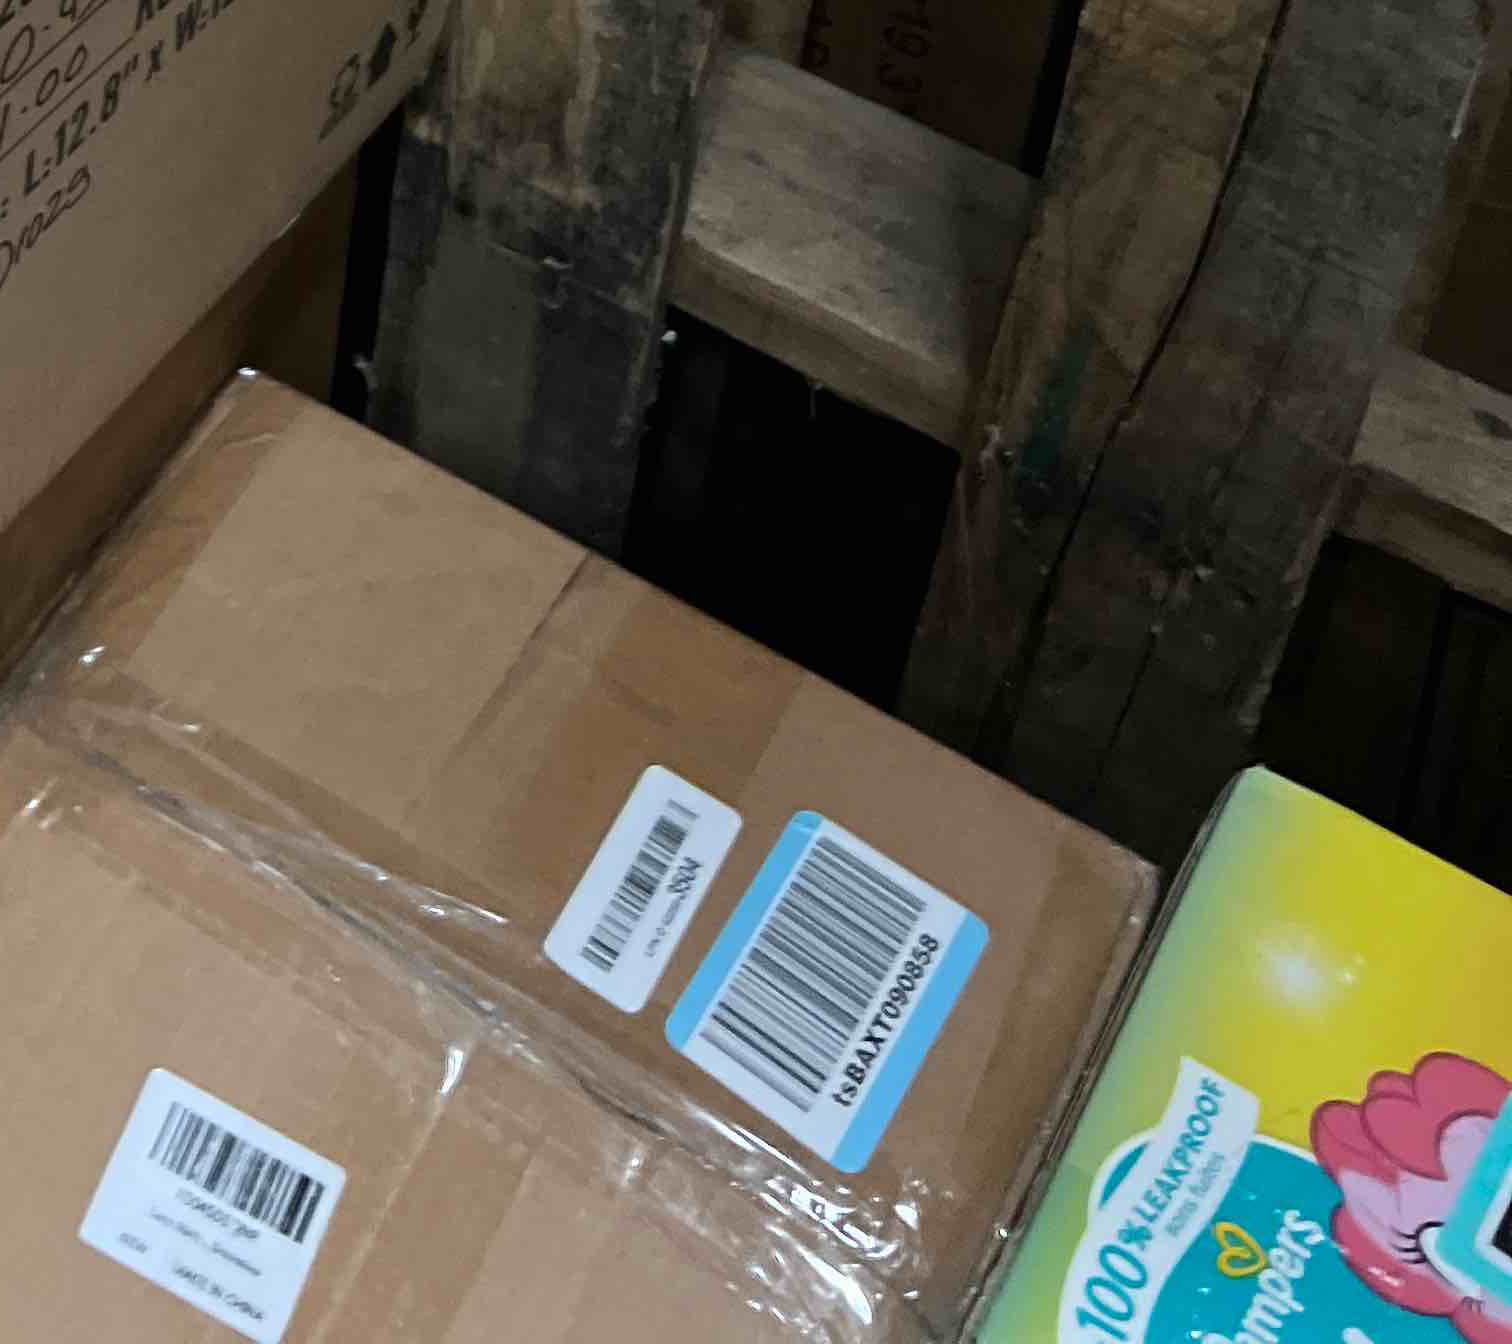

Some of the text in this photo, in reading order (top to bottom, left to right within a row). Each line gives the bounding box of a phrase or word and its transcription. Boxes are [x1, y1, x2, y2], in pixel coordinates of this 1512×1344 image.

[1075, 1076, 1226, 1343] 100% LEAKPROOF
[1201, 1209, 1326, 1344] mpers
